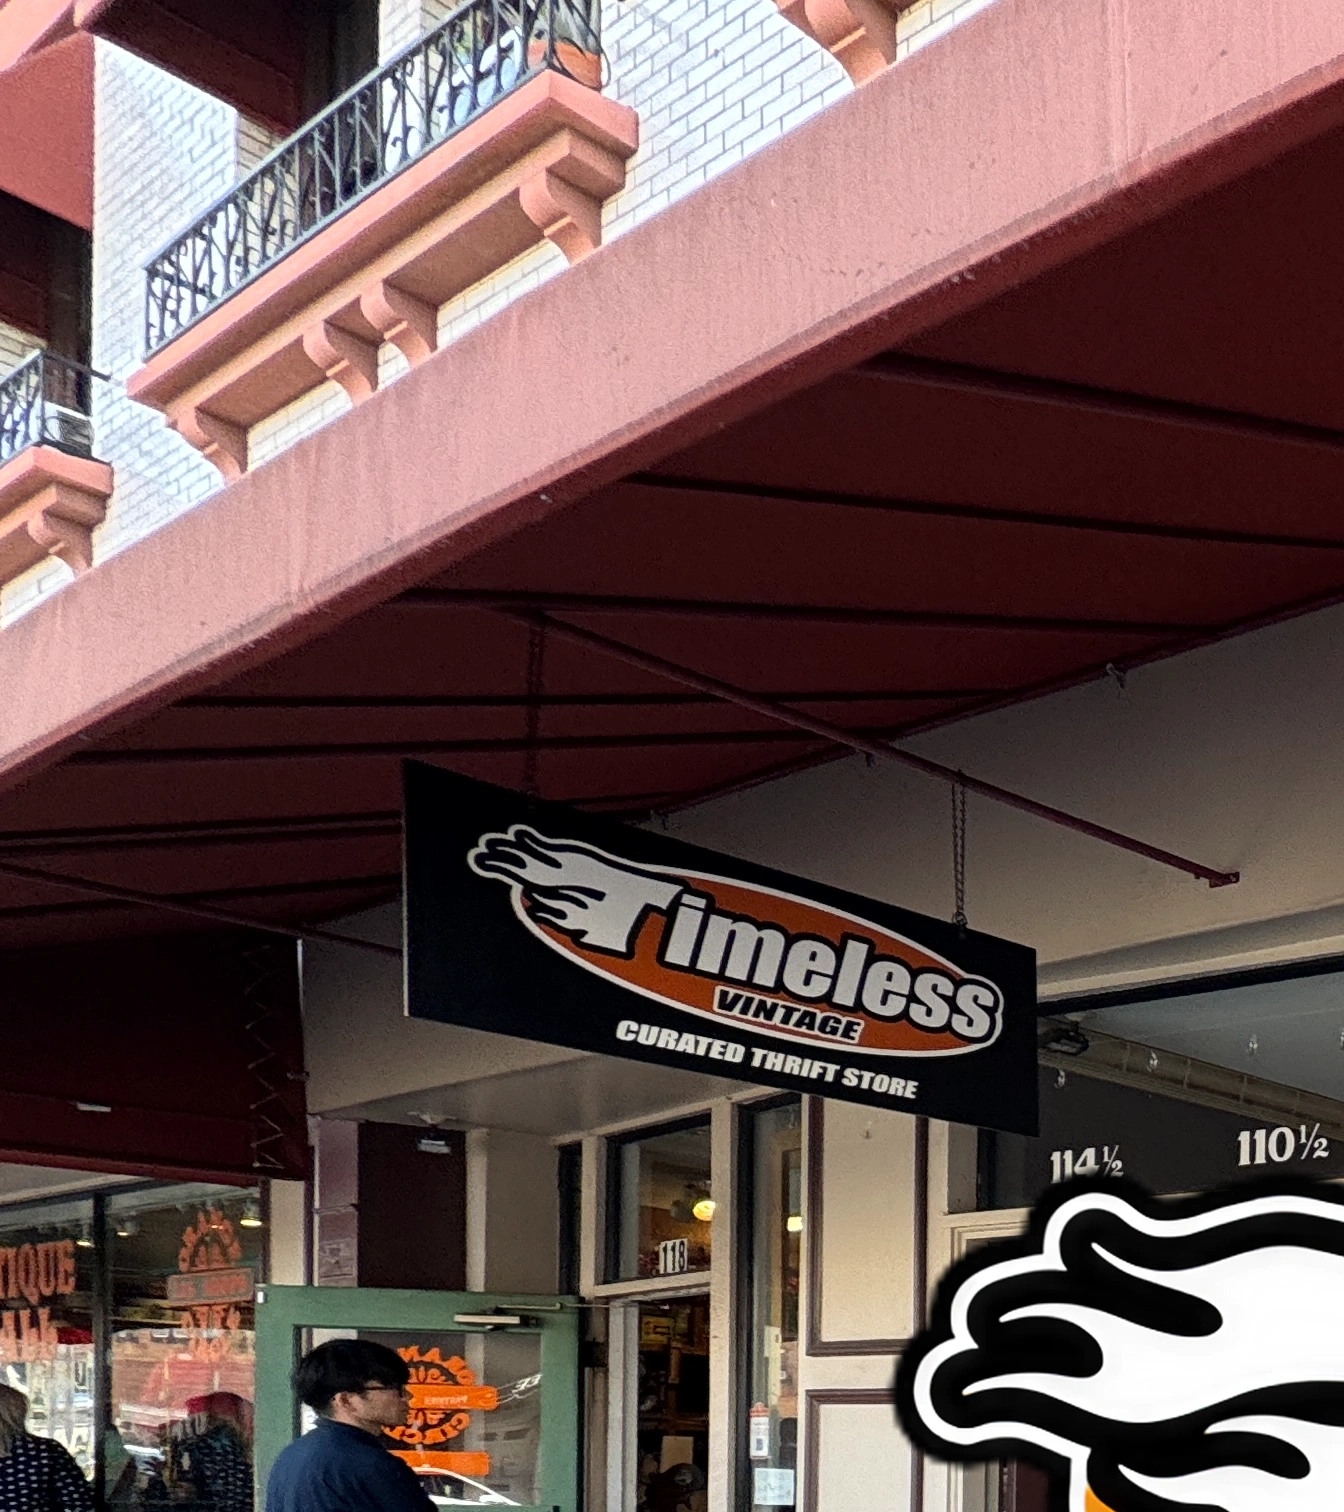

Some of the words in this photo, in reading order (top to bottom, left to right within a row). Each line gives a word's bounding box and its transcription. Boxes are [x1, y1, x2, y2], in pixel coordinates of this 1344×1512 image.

[470, 827, 1002, 1043] Timeless
[717, 989, 861, 1041] VINTAGE
[616, 1020, 745, 1063] CURATED
[751, 1047, 841, 1083] THRIFT
[841, 1067, 919, 1099] STORE
[662, 1240, 686, 1273] 118
